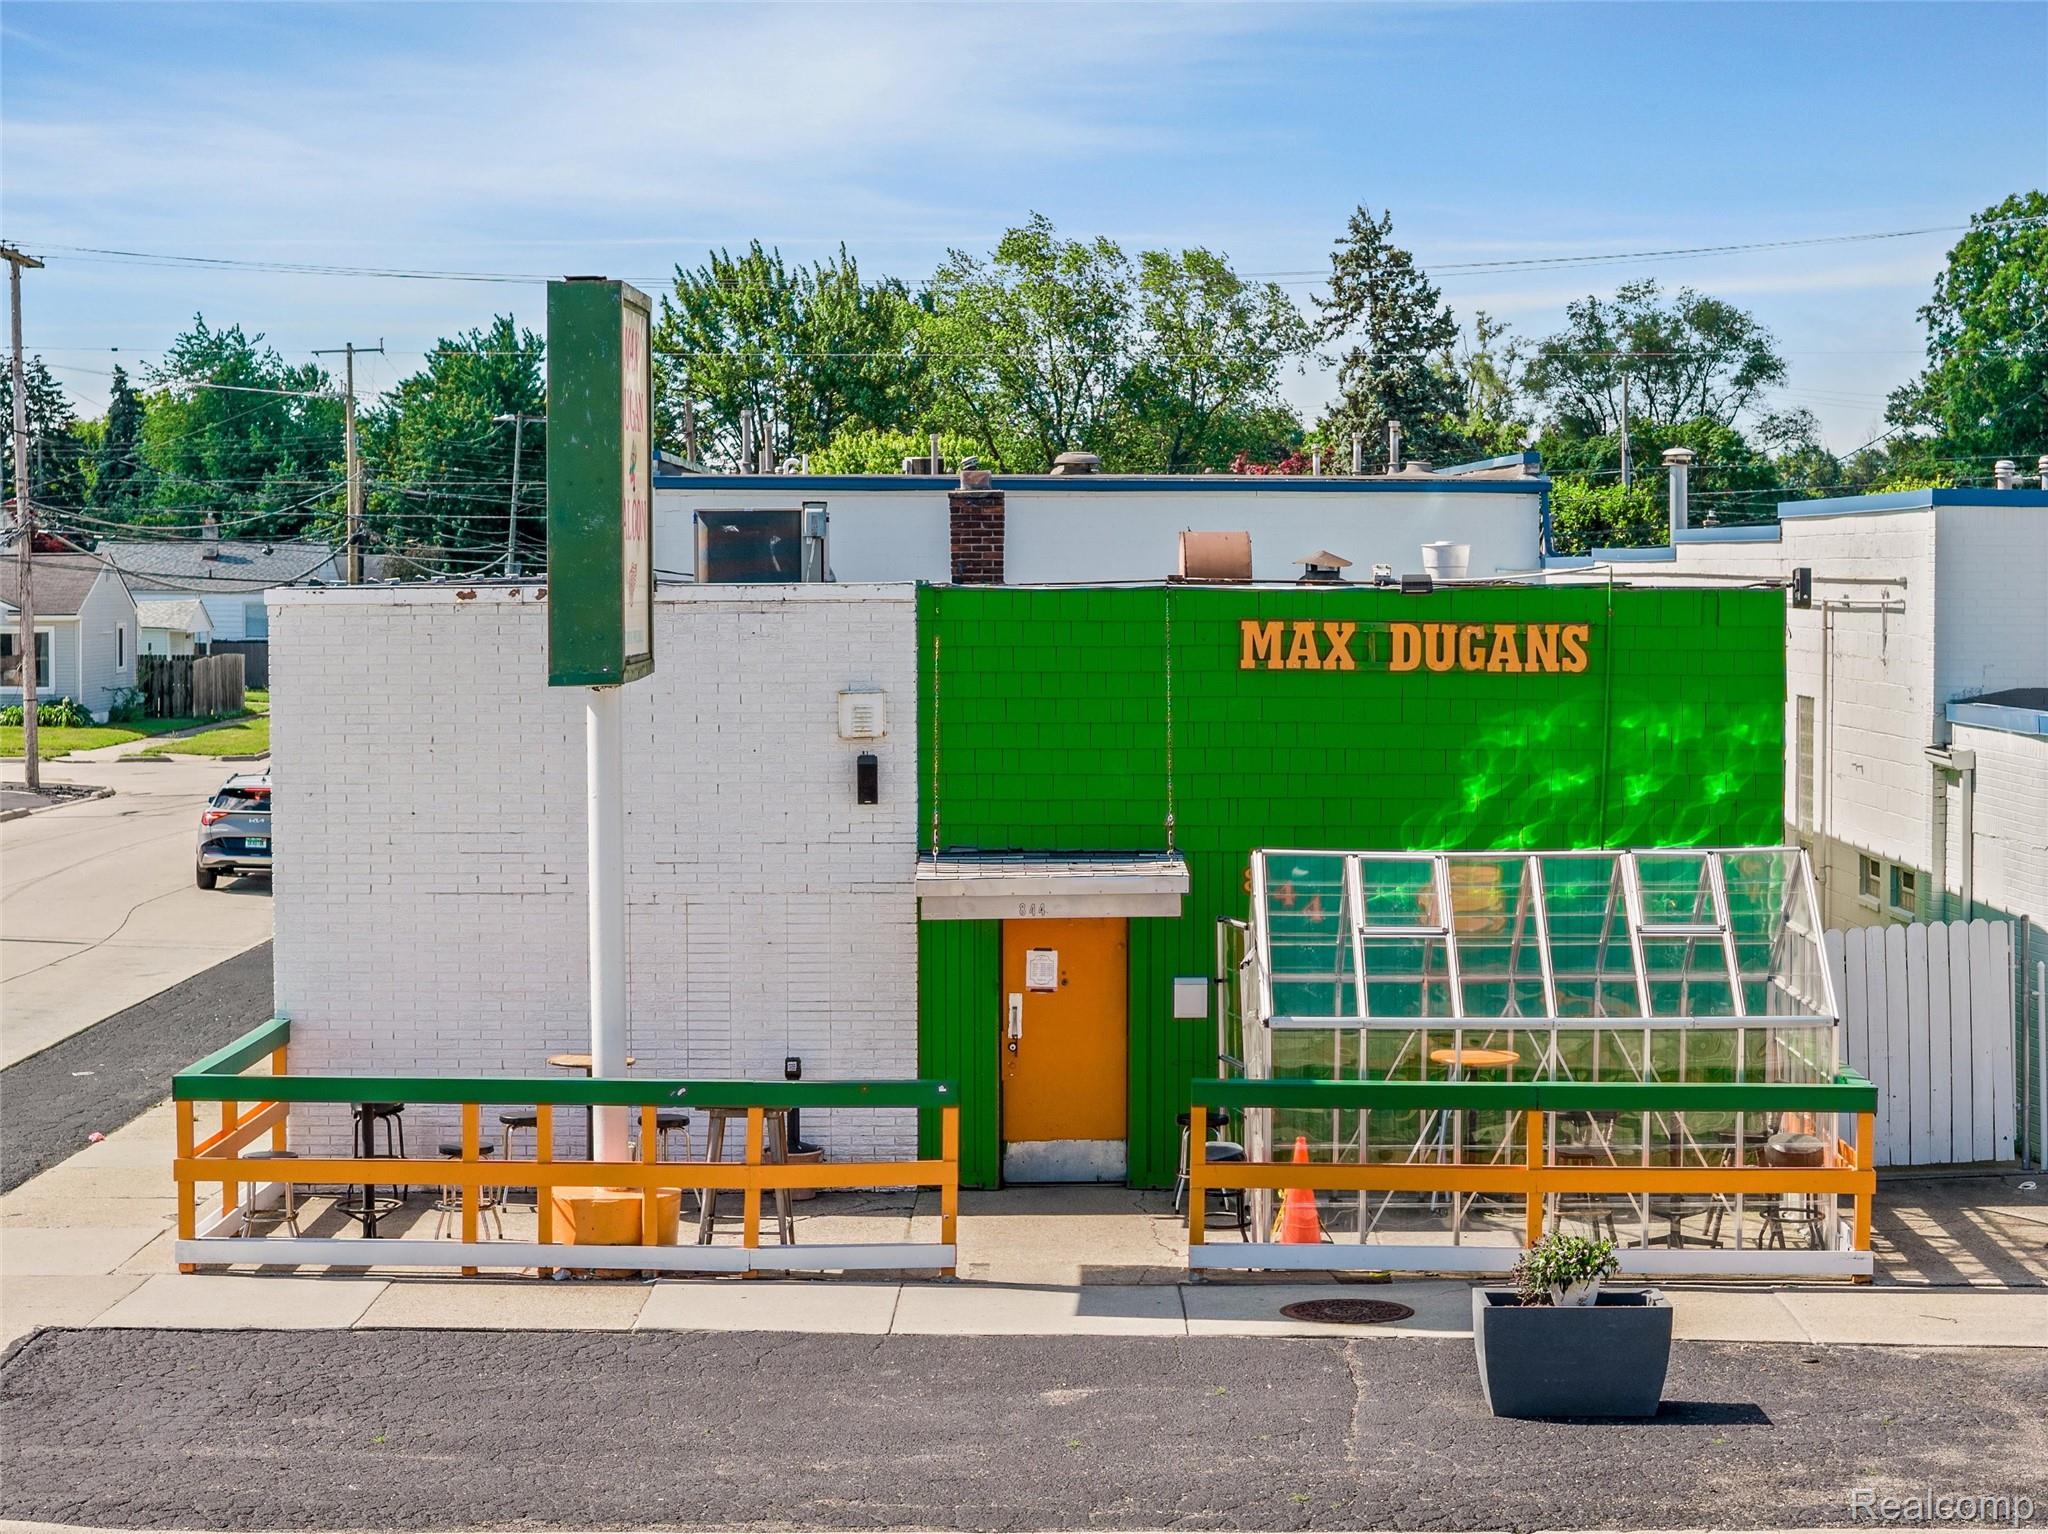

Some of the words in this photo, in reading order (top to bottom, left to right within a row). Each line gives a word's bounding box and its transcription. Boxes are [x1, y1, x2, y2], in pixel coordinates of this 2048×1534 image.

[624, 388, 644, 432] UGAN
[623, 497, 647, 541] ALOON
[1240, 620, 1356, 671] MAX
[1389, 622, 1590, 673] DUGANS
[1018, 902, 1048, 917] 844
